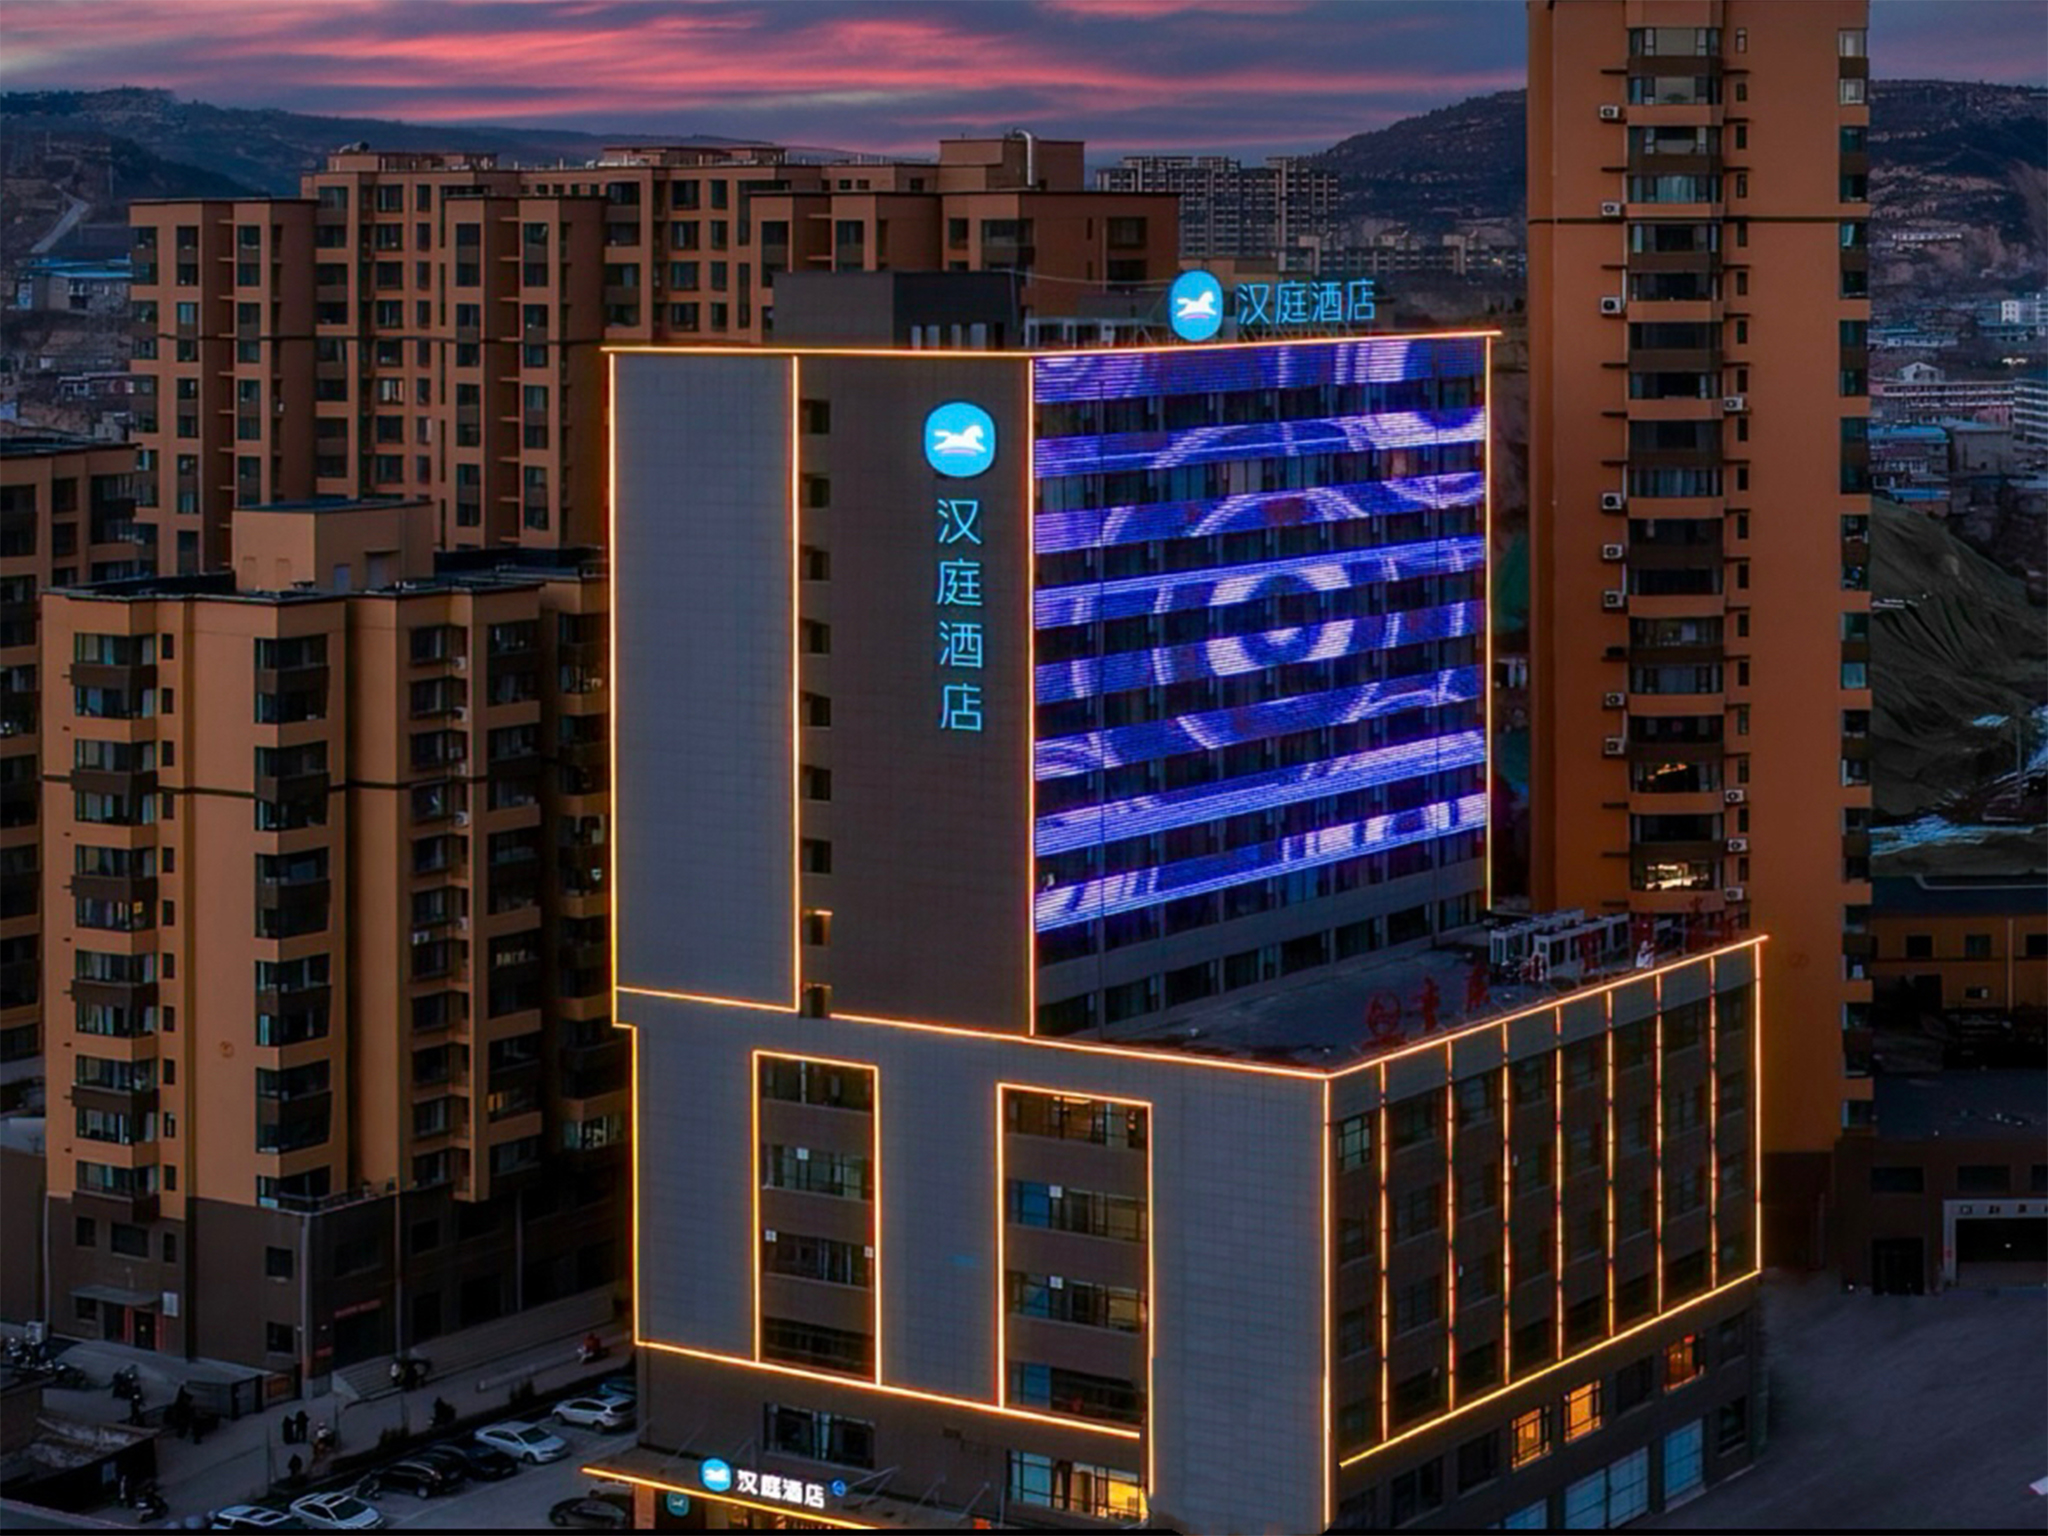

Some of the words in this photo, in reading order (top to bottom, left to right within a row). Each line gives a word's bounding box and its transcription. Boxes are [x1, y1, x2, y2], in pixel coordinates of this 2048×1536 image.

[1238, 279, 1375, 325] 汉庭酒店
[936, 498, 983, 732] 汉庭酒店
[737, 1469, 824, 1509] 汉庭酒店
